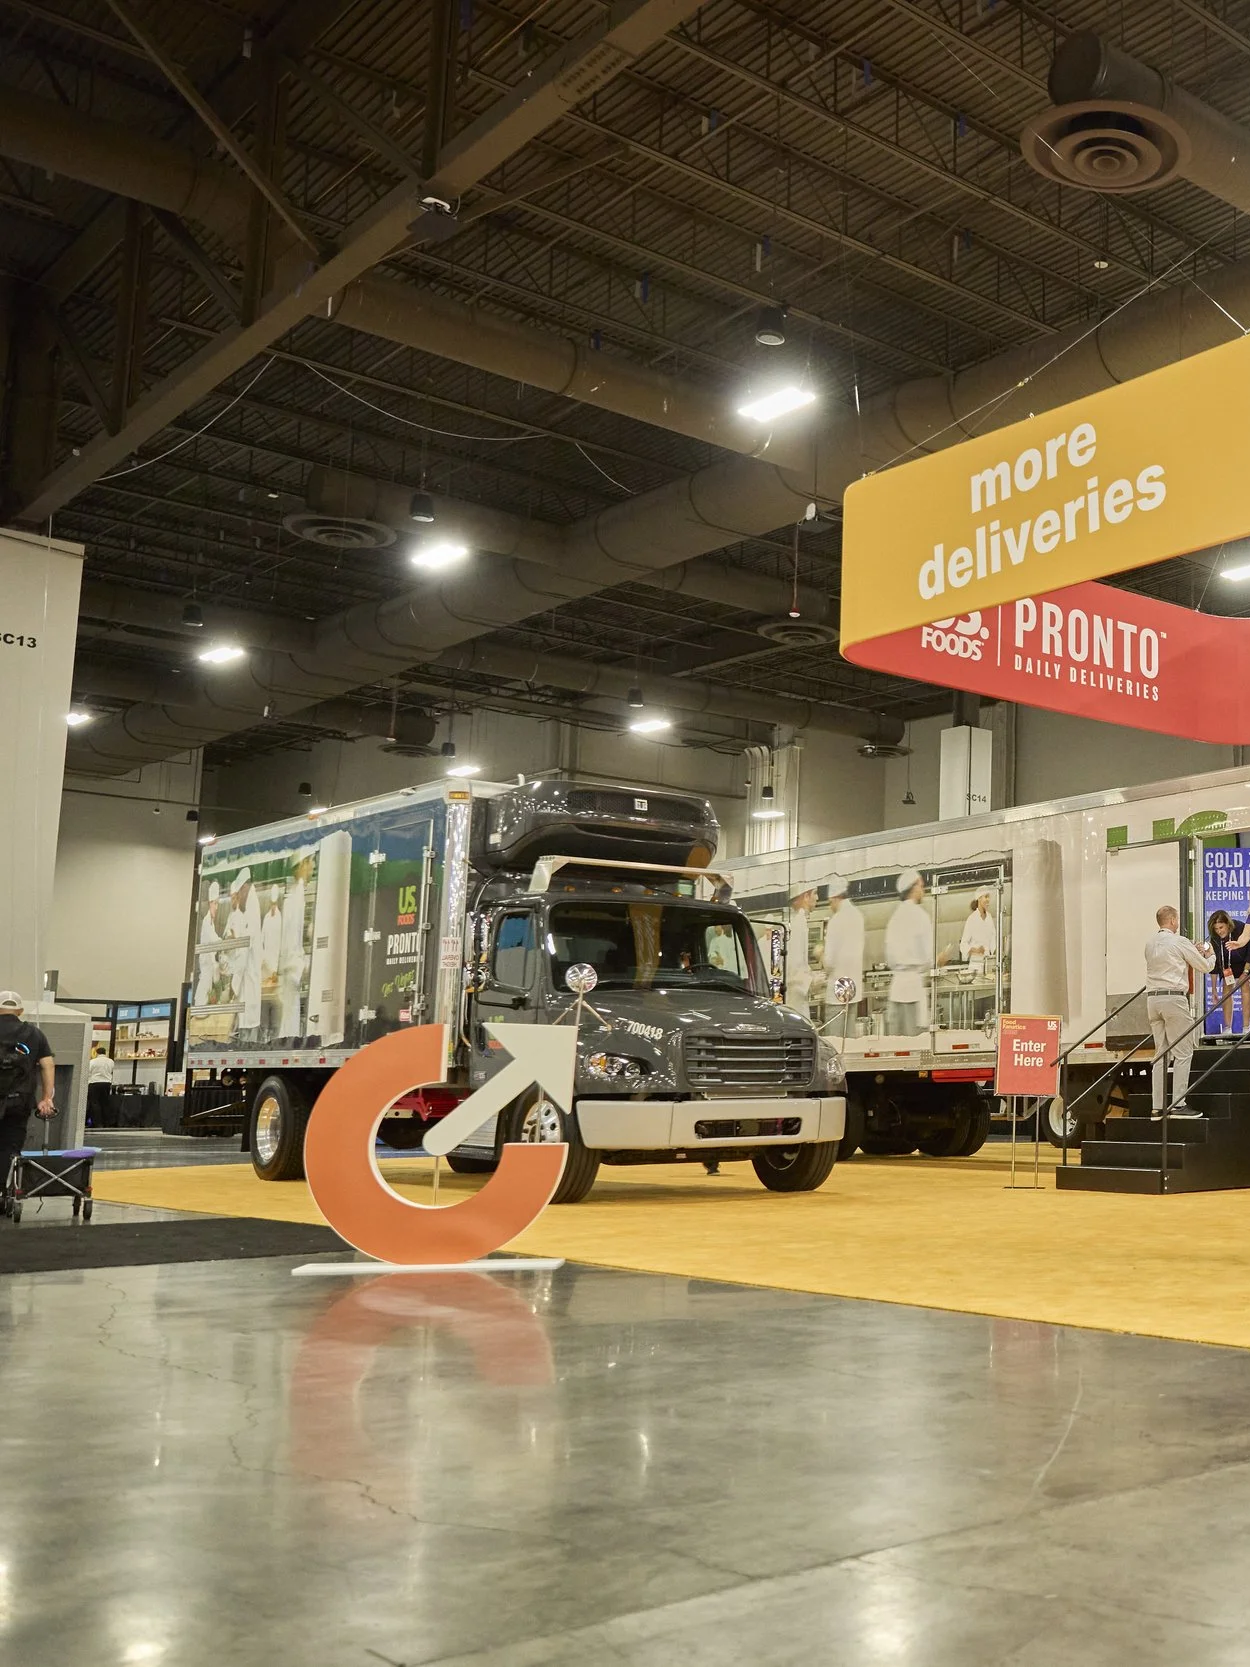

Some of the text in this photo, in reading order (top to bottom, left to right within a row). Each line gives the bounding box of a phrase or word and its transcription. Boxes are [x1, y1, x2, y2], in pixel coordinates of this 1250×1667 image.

[970, 423, 1097, 513] more
[918, 464, 1167, 600] deliveries
[0, 633, 37, 648] C13
[1014, 654, 1159, 701] DAILY DELIVERIES
[966, 793, 987, 803] SC14
[1205, 852, 1243, 868] COLD
[1206, 890, 1244, 901] KEEPING
[627, 1020, 664, 1040] 700418
[1013, 1039, 1046, 1052] Enter
[1014, 1054, 1043, 1067] Here
